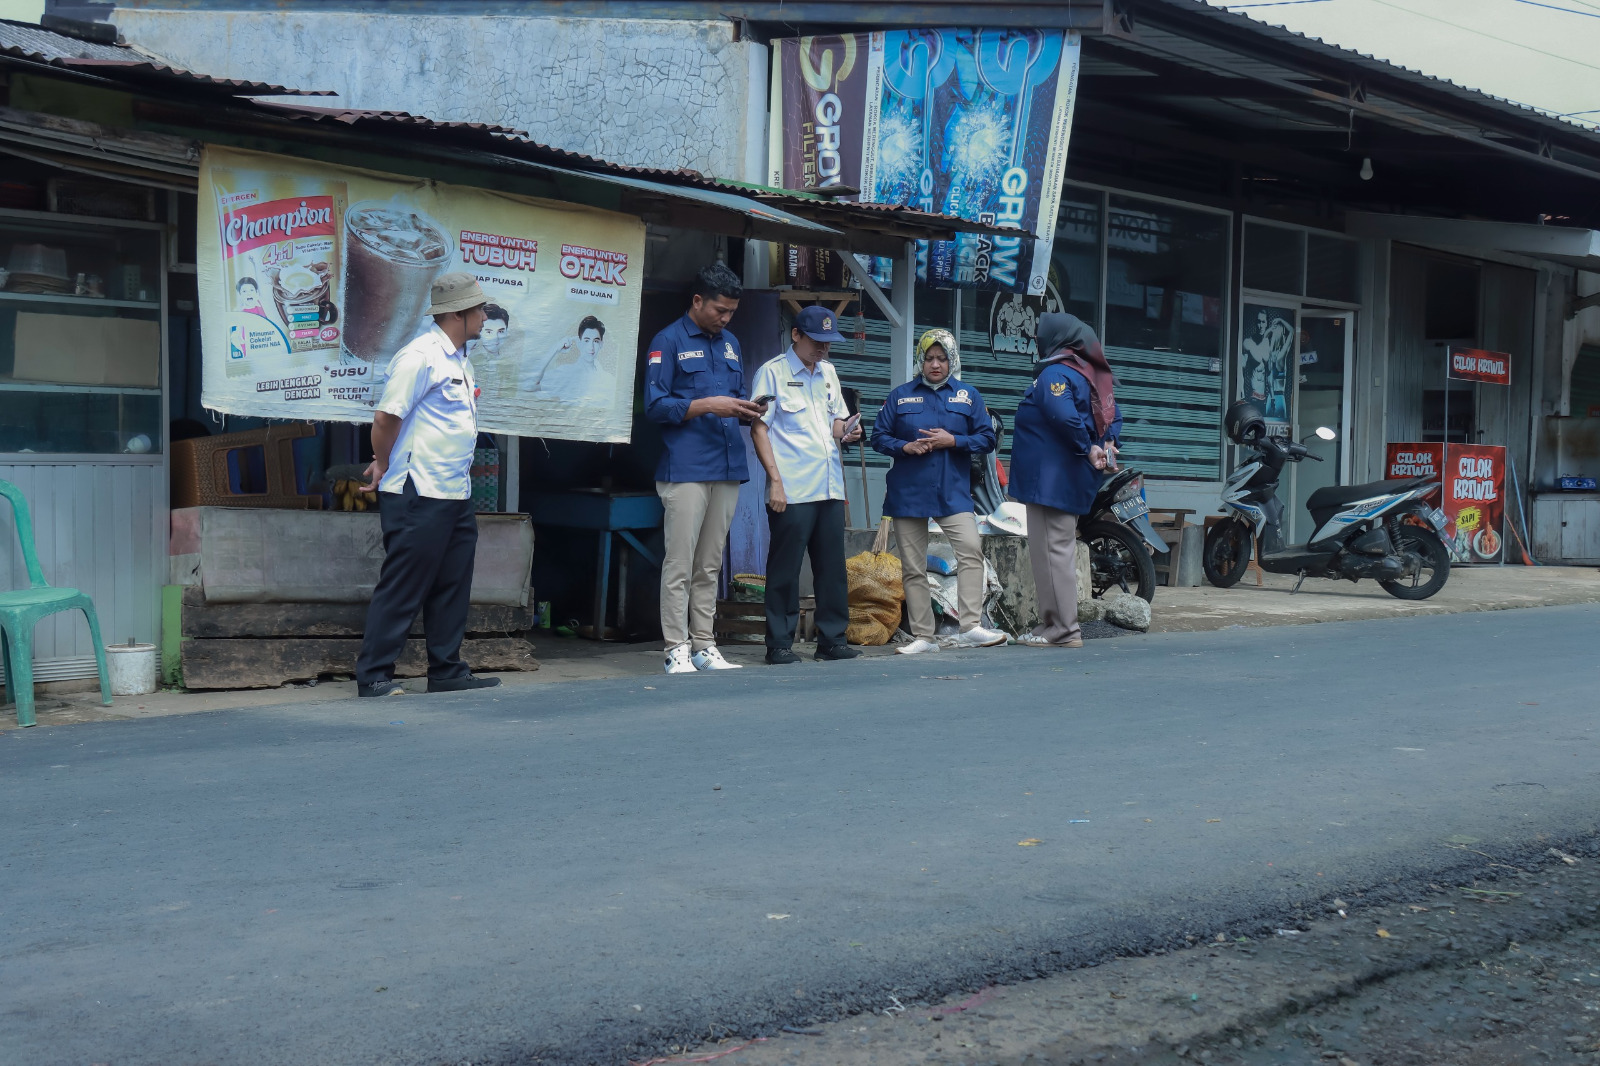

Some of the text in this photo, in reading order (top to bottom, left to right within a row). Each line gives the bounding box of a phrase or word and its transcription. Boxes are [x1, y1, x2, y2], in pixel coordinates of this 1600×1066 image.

[802, 122, 816, 188] FILTER
[226, 200, 331, 247] Champion
[461, 232, 537, 250] ENERGI UNTUK
[972, 212, 995, 283] BACK
[461, 244, 536, 272] TUBUH
[562, 244, 628, 262] ENERGI UNTUK
[560, 255, 627, 286] OTAK
[492, 278, 524, 287] PUASA
[570, 288, 613, 300] SIAP UJIAN
[330, 366, 368, 378] SUSU
[1454, 356, 1506, 375] CILOK KRIWIL
[257, 374, 322, 392] LEBIH LENGKAP
[285, 388, 320, 400] DENGAN
[1397, 452, 1432, 464] CILOK
[1392, 464, 1437, 476] KRIWIL
[1460, 458, 1492, 479] CILOK
[1454, 479, 1496, 501] KRIWIL
[1461, 513, 1475, 524] SAPI
